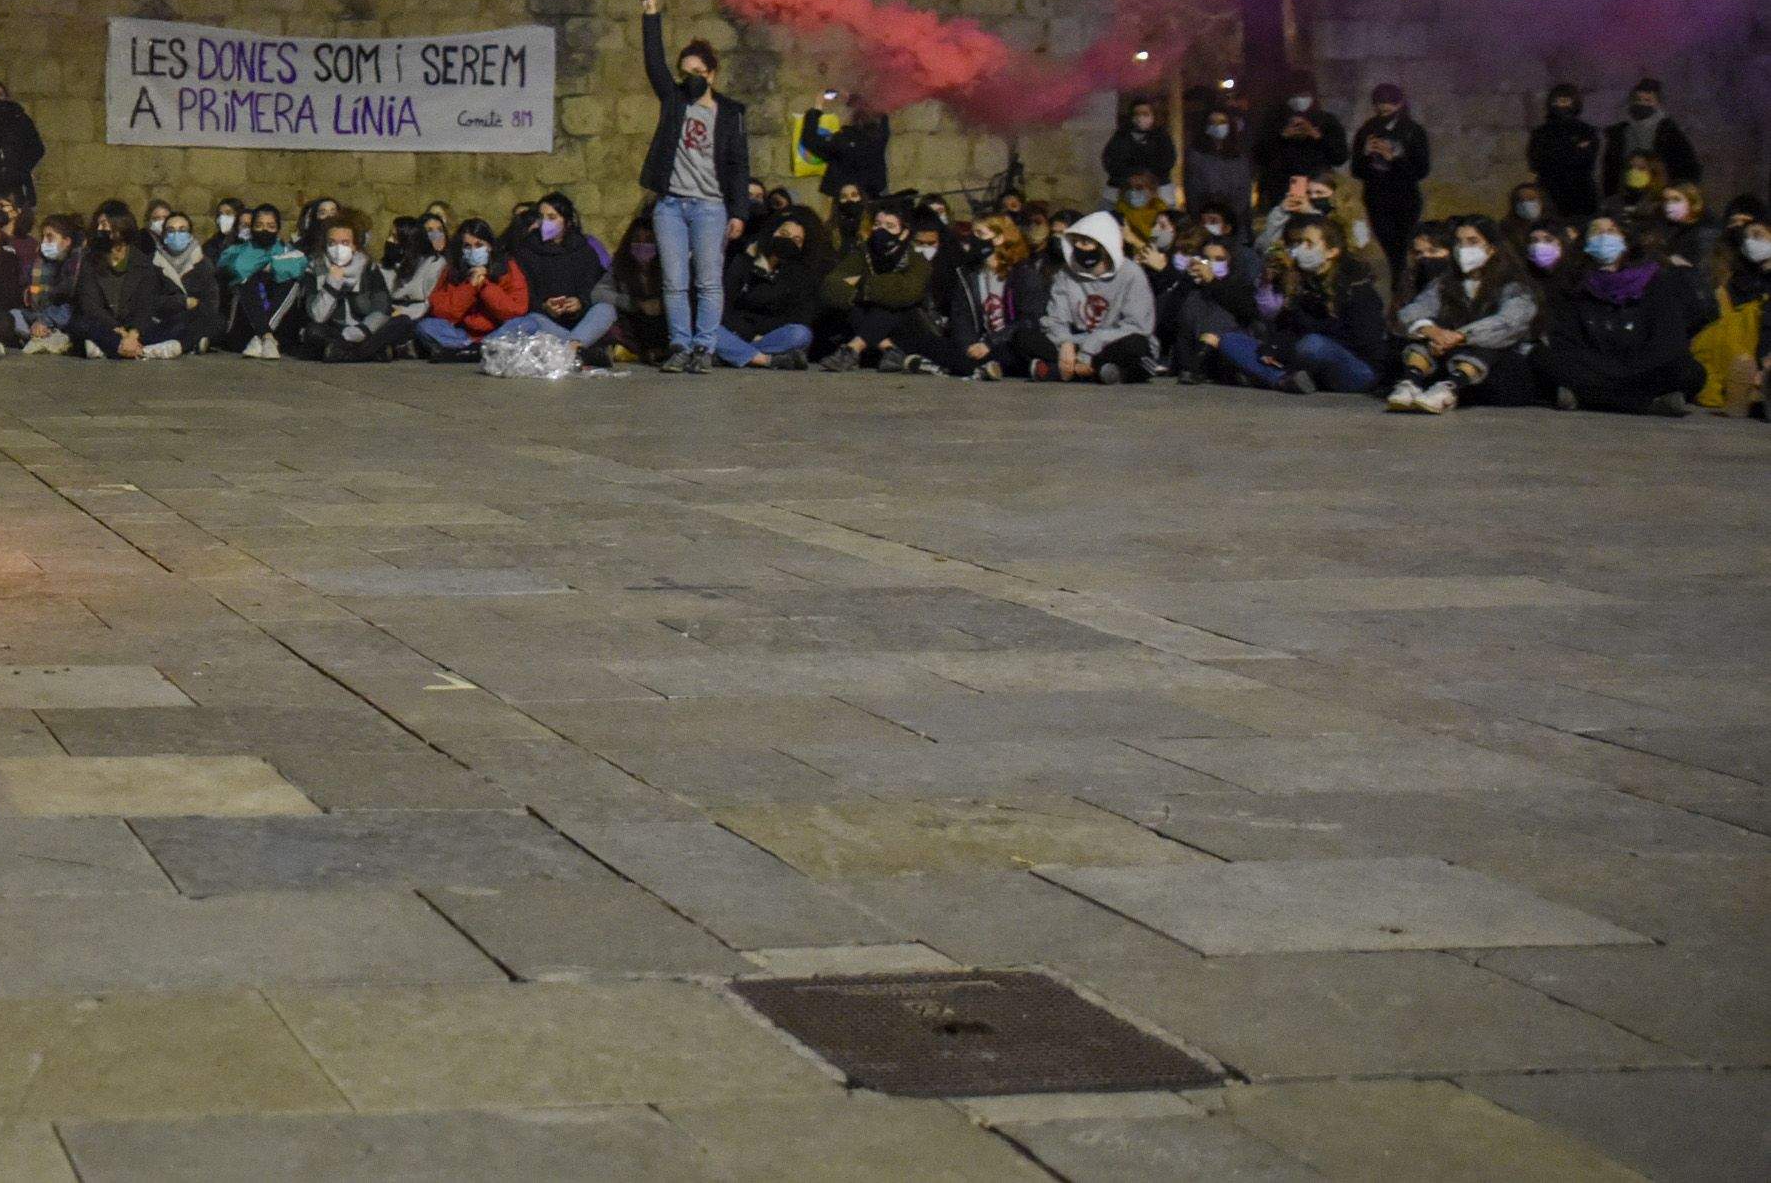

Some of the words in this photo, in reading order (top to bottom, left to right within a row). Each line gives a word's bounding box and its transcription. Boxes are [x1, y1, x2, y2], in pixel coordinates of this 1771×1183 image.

[131, 37, 188, 80] LES
[198, 38, 298, 84] DONES
[314, 43, 382, 83] SOM
[421, 44, 527, 88] SEREM
[130, 86, 161, 129] A
